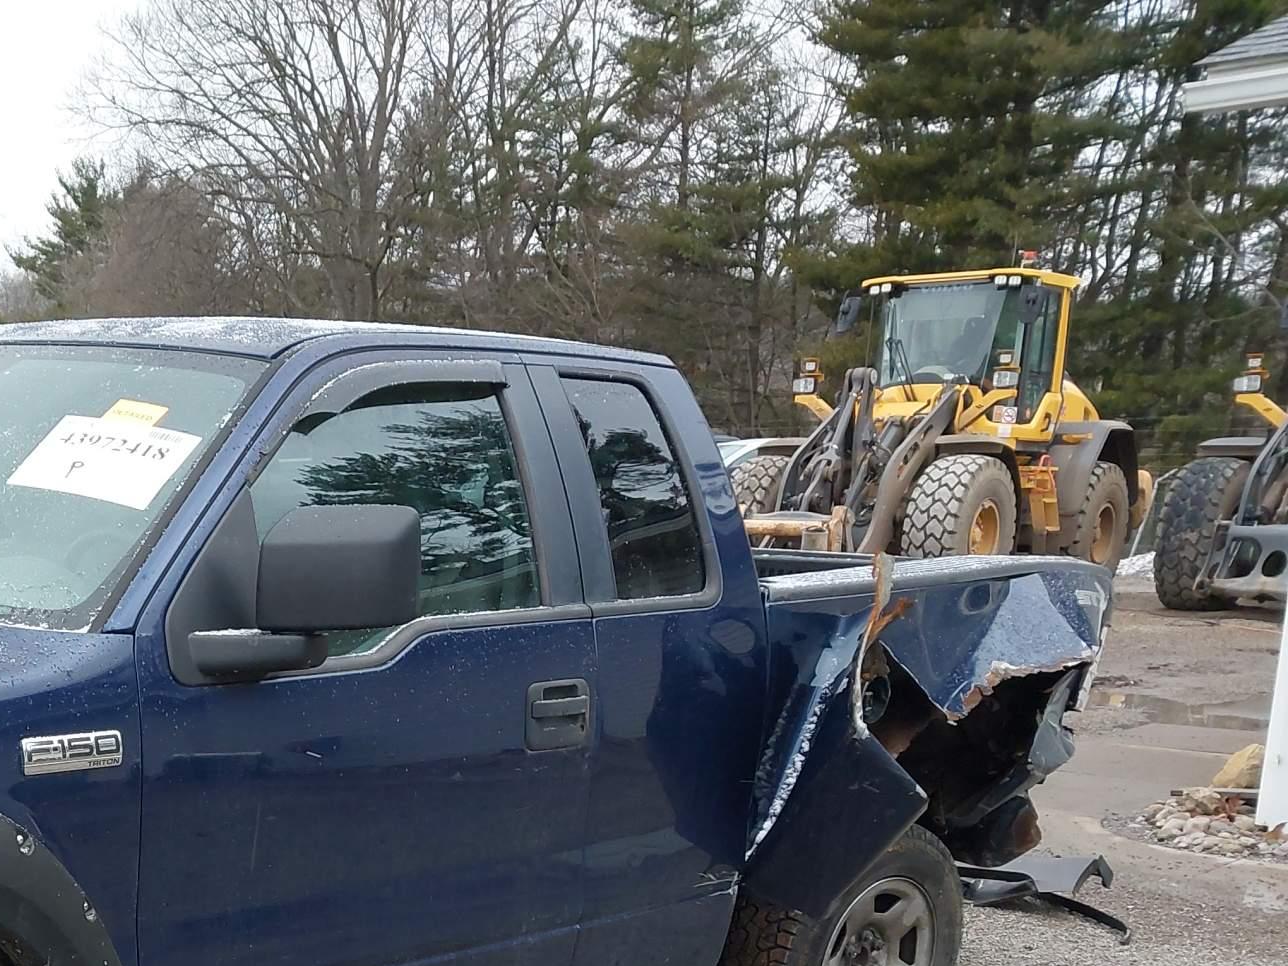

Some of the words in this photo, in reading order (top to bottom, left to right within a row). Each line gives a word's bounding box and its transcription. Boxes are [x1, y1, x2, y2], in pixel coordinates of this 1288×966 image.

[60, 432, 170, 460] 43972418
[25, 734, 121, 762] F-150
[87, 757, 120, 767] TRITON
